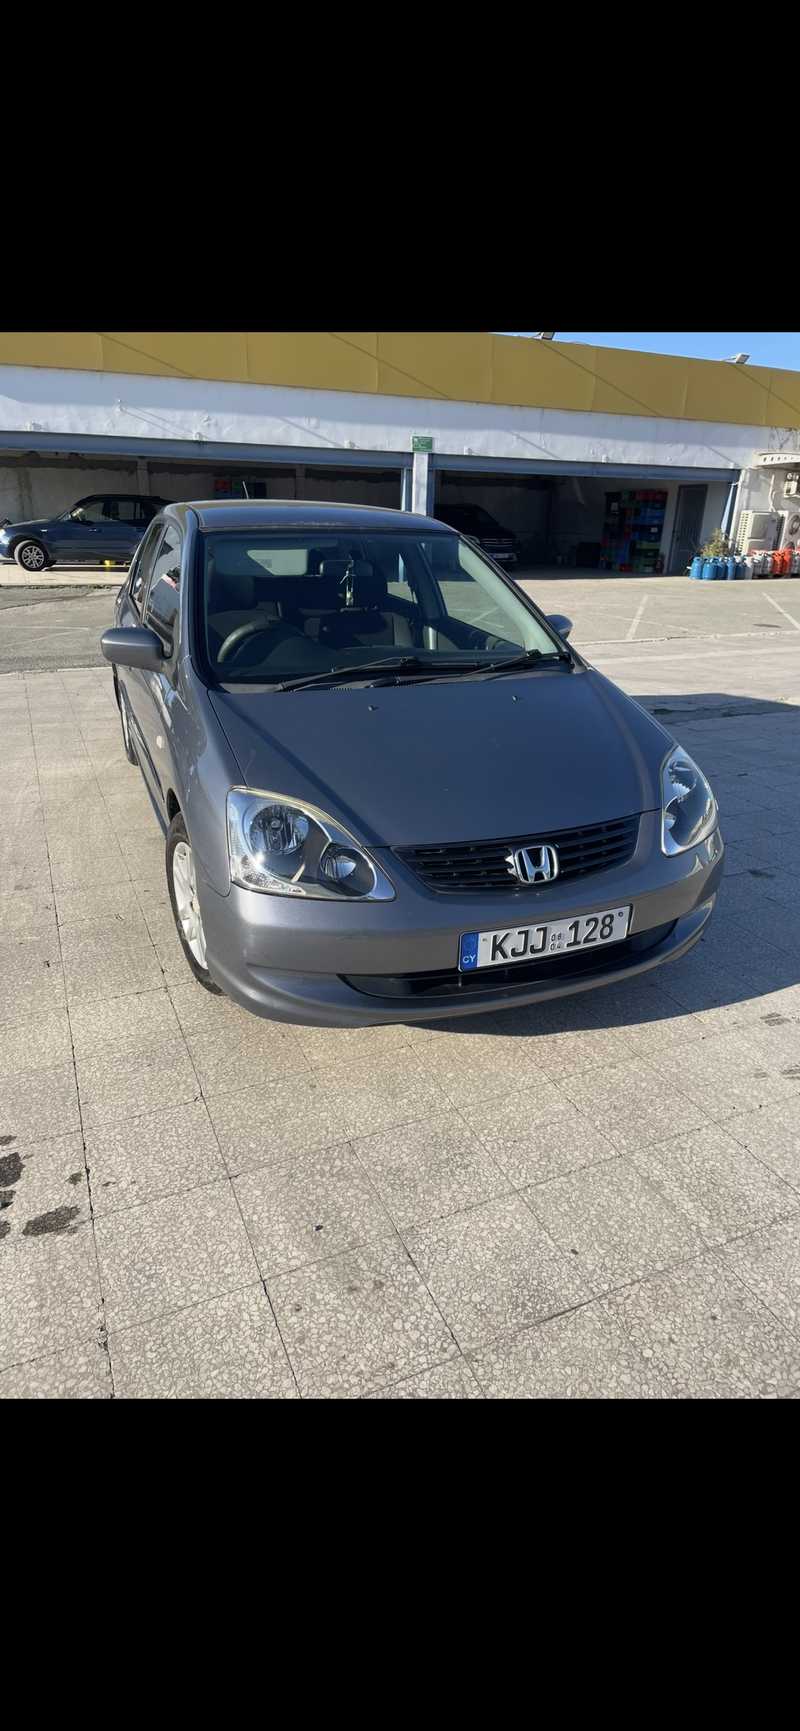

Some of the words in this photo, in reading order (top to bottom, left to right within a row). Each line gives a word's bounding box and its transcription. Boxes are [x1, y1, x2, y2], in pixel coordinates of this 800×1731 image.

[491, 926, 548, 961] KJJ
[566, 914, 615, 948] 128
[462, 953, 476, 964] CY
